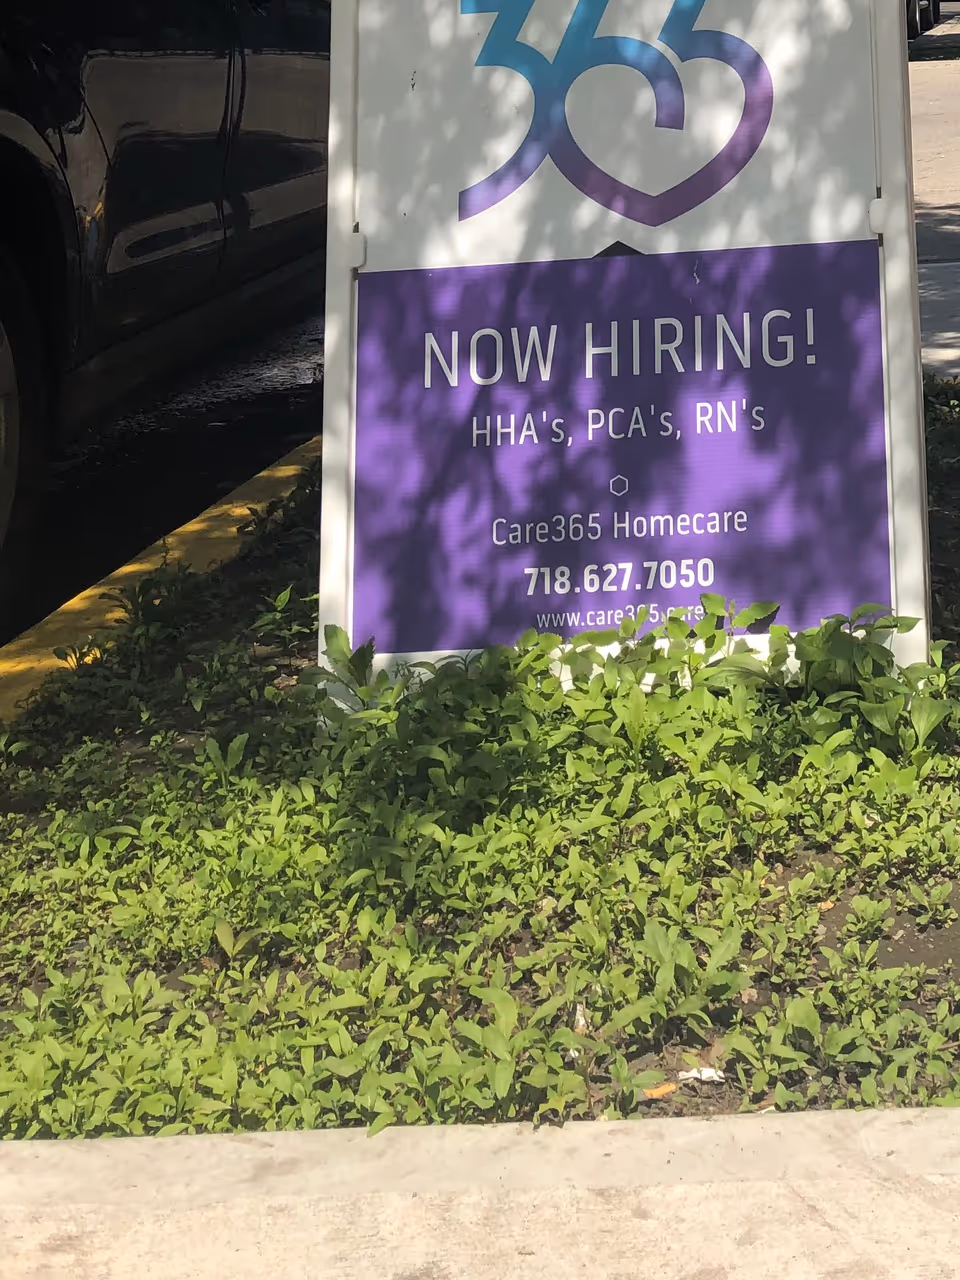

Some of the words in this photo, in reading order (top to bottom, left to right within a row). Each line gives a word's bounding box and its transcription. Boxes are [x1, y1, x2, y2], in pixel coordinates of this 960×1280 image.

[423, 324, 558, 389] NOW
[585, 308, 816, 380] HIRING!
[472, 410, 573, 448] HHA's,
[587, 404, 681, 441] PCA's,
[695, 398, 765, 434] RN's
[492, 513, 602, 546] Care365
[613, 506, 748, 539] Homecare
[524, 557, 715, 596] 718.627.7050
